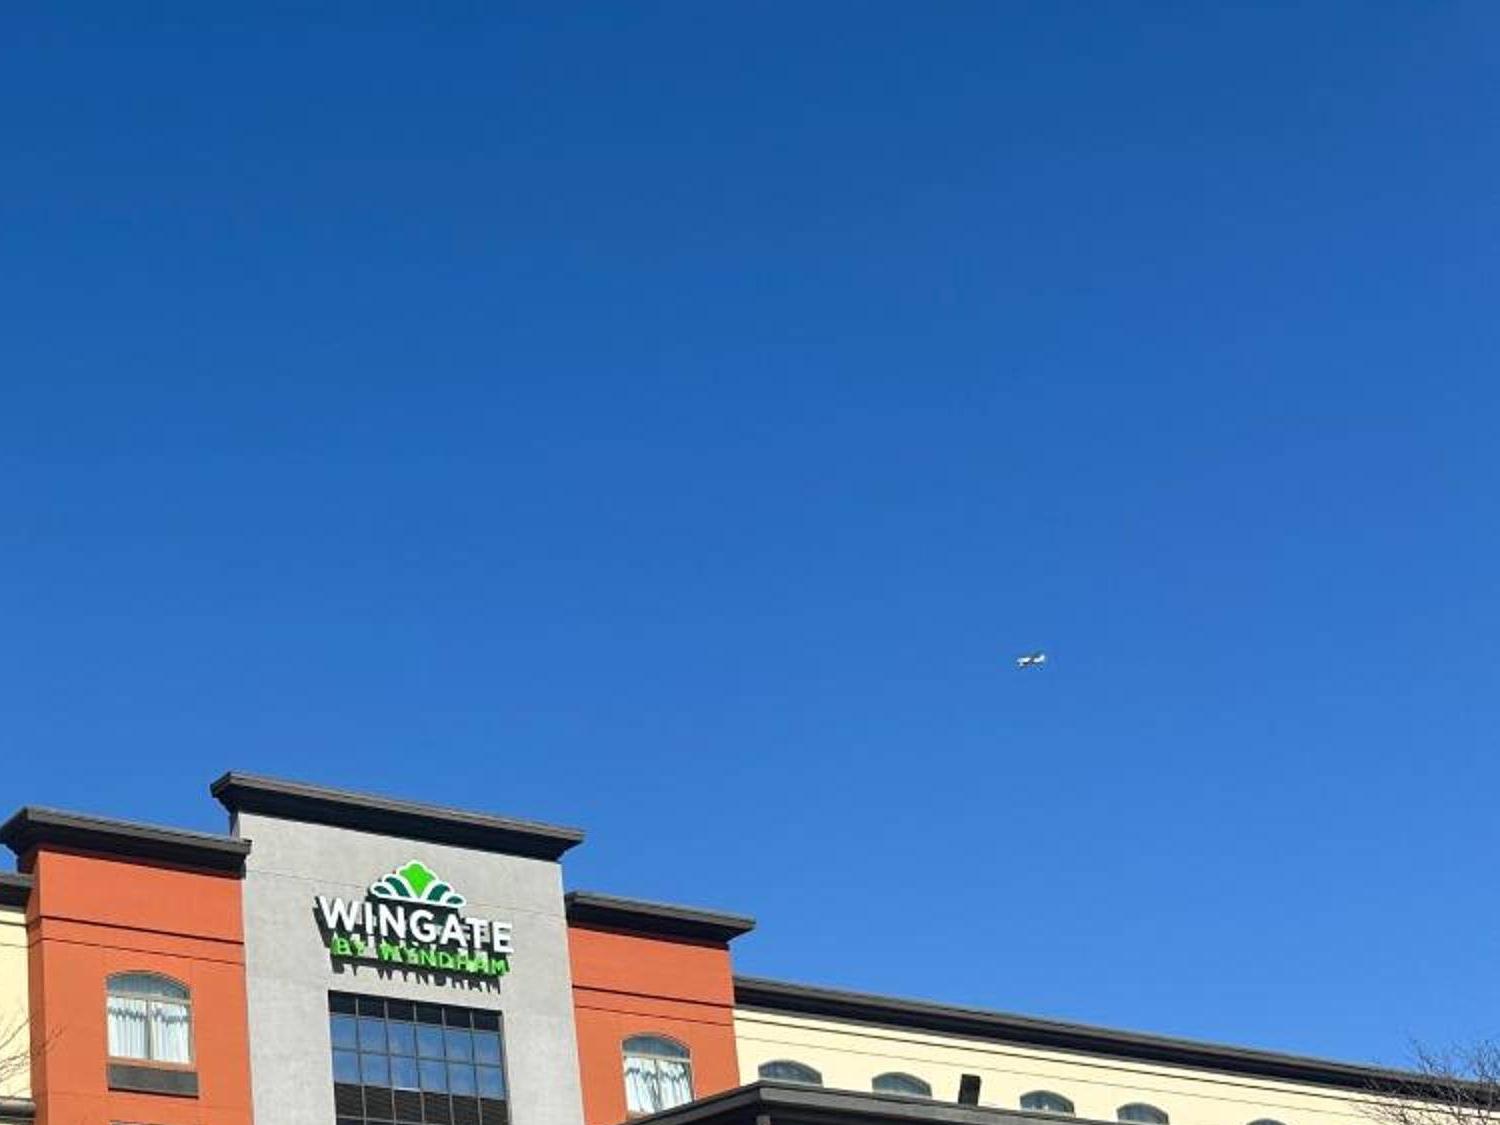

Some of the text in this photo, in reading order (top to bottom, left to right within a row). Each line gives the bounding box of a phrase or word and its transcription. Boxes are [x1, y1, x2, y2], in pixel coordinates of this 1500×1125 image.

[319, 895, 514, 954] WINGATE
[331, 936, 510, 976] BY WYNDHAM
